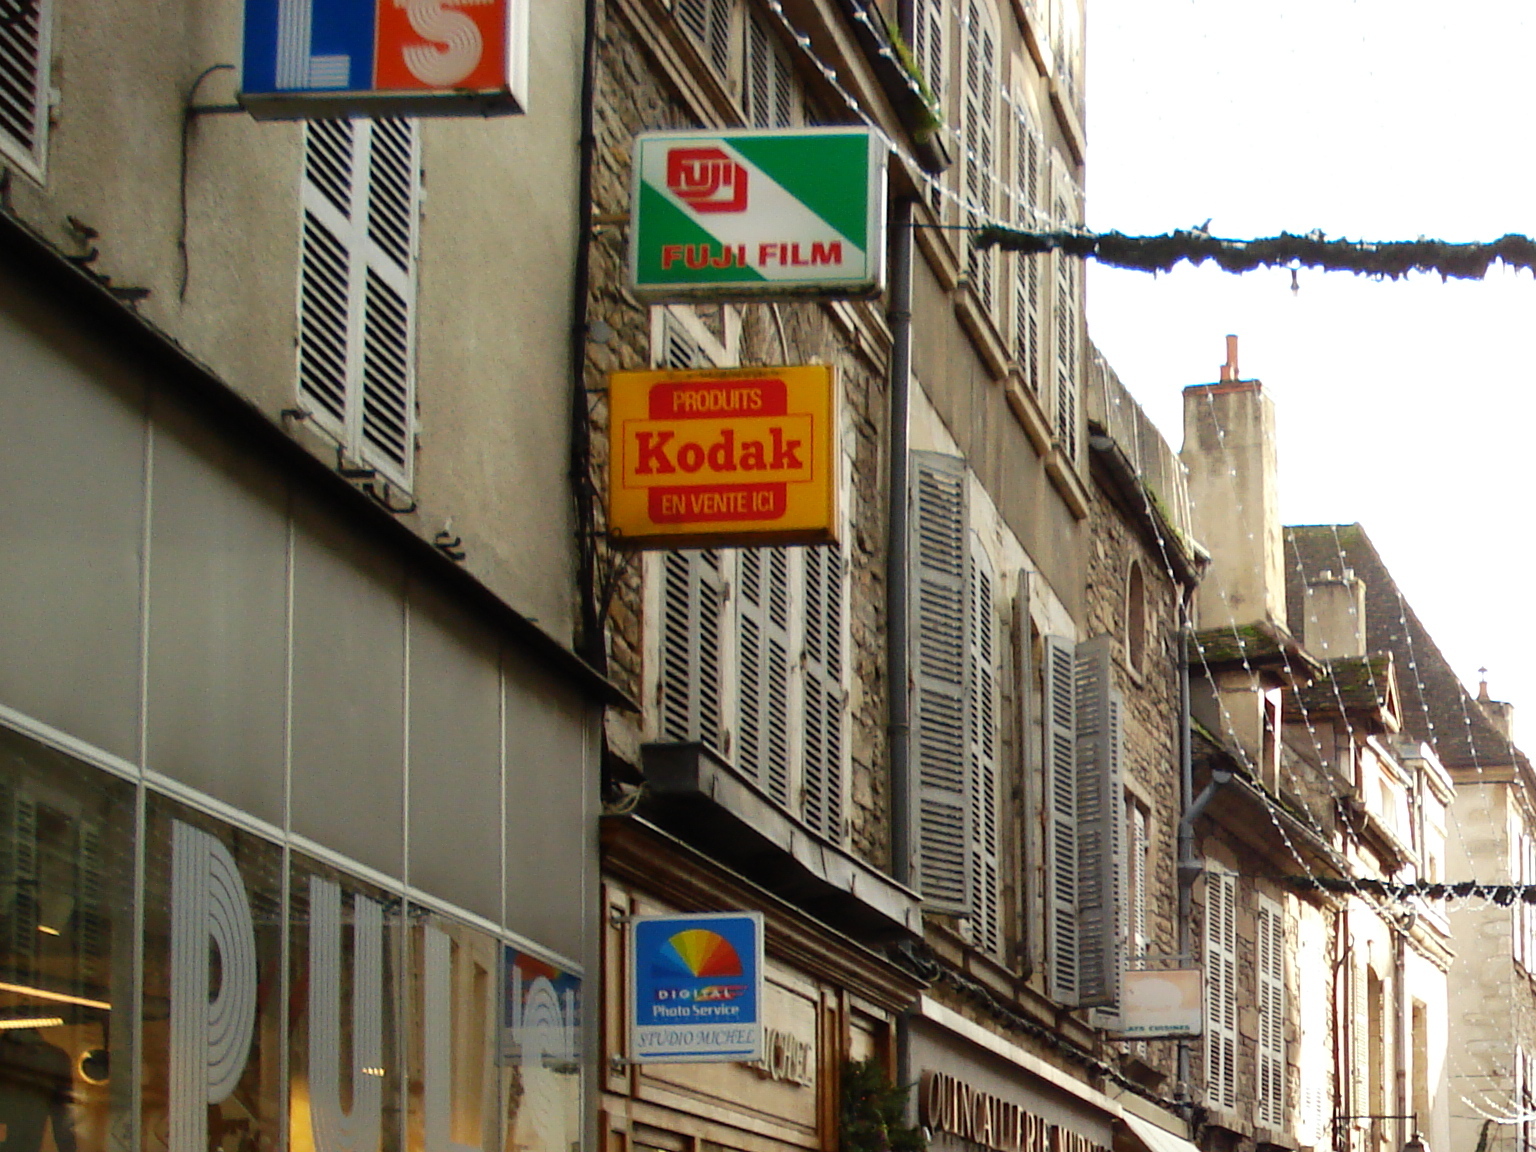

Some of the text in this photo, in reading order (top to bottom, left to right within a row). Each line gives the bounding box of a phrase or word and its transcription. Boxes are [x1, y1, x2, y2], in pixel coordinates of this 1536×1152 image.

[661, 240, 842, 270] FUJI FILM
[673, 388, 762, 413] PRODUITS
[635, 427, 803, 475] Kodak
[662, 491, 774, 515] EN VENTE ICI
[658, 987, 730, 1000] DIGITAL
[652, 1003, 739, 1017] Photo Service
[638, 1029, 754, 1048] STUDIO MICHEL
